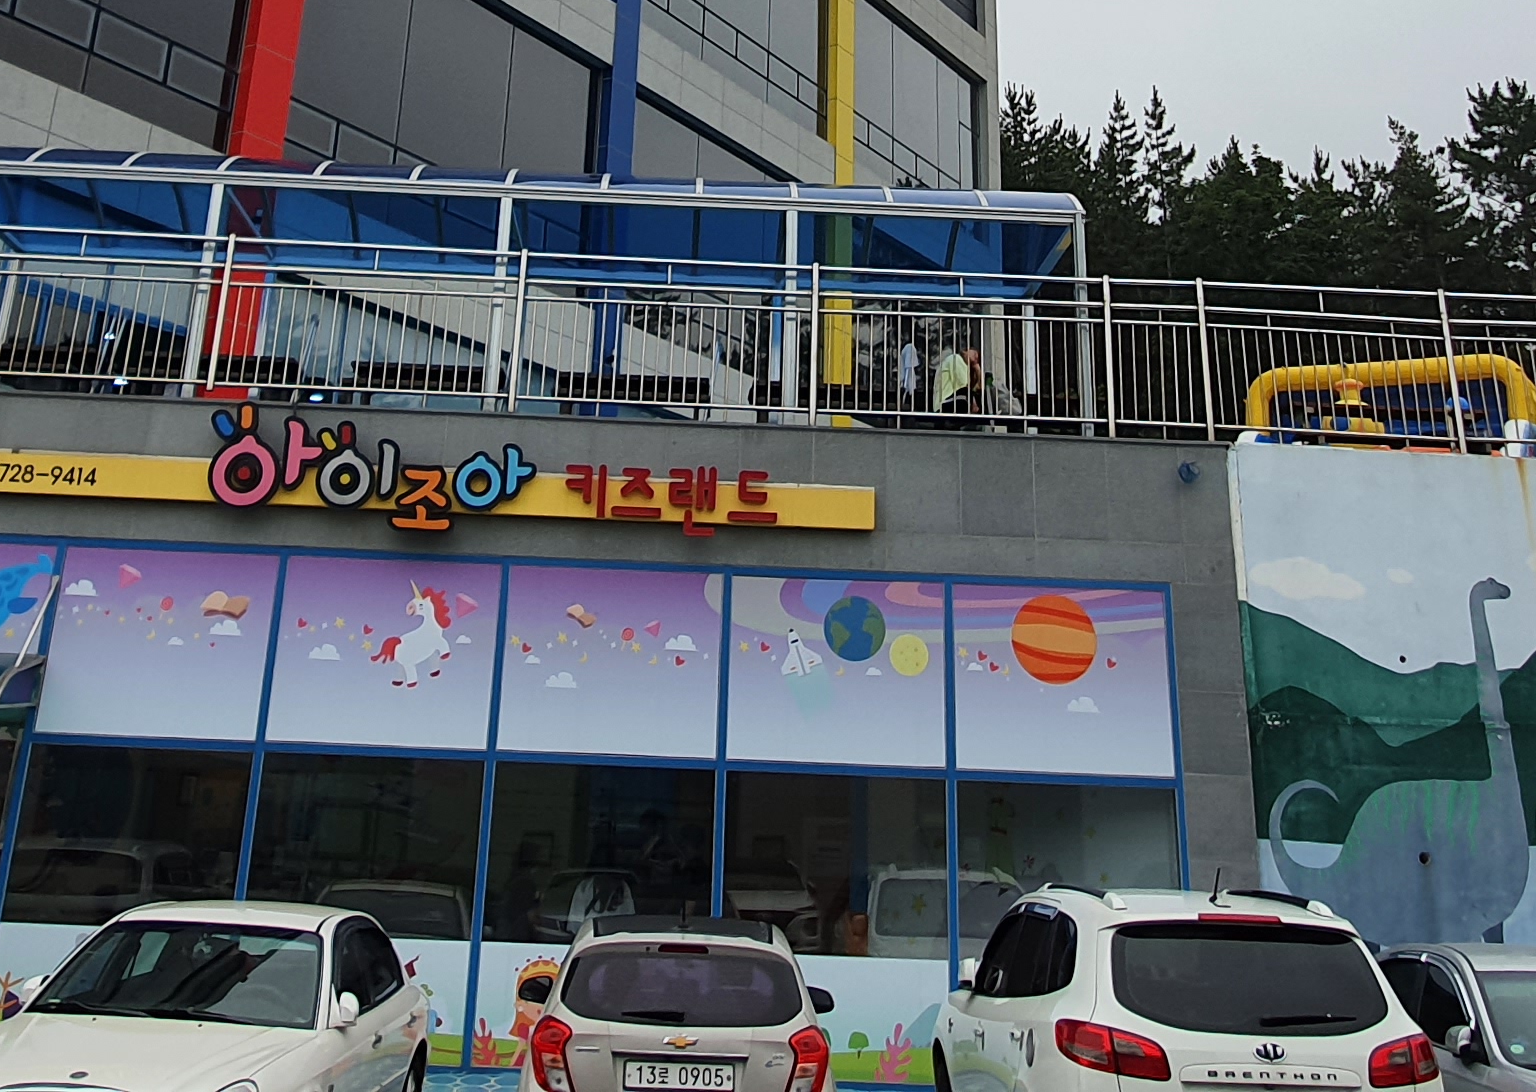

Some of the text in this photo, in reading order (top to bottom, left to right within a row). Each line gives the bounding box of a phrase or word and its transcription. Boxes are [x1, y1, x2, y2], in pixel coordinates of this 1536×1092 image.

[208, 401, 778, 537] 아이조아 키즈랜드
[635, 1065, 724, 1087] 13로 0905
[1207, 1069, 1338, 1081] BRENTHON
